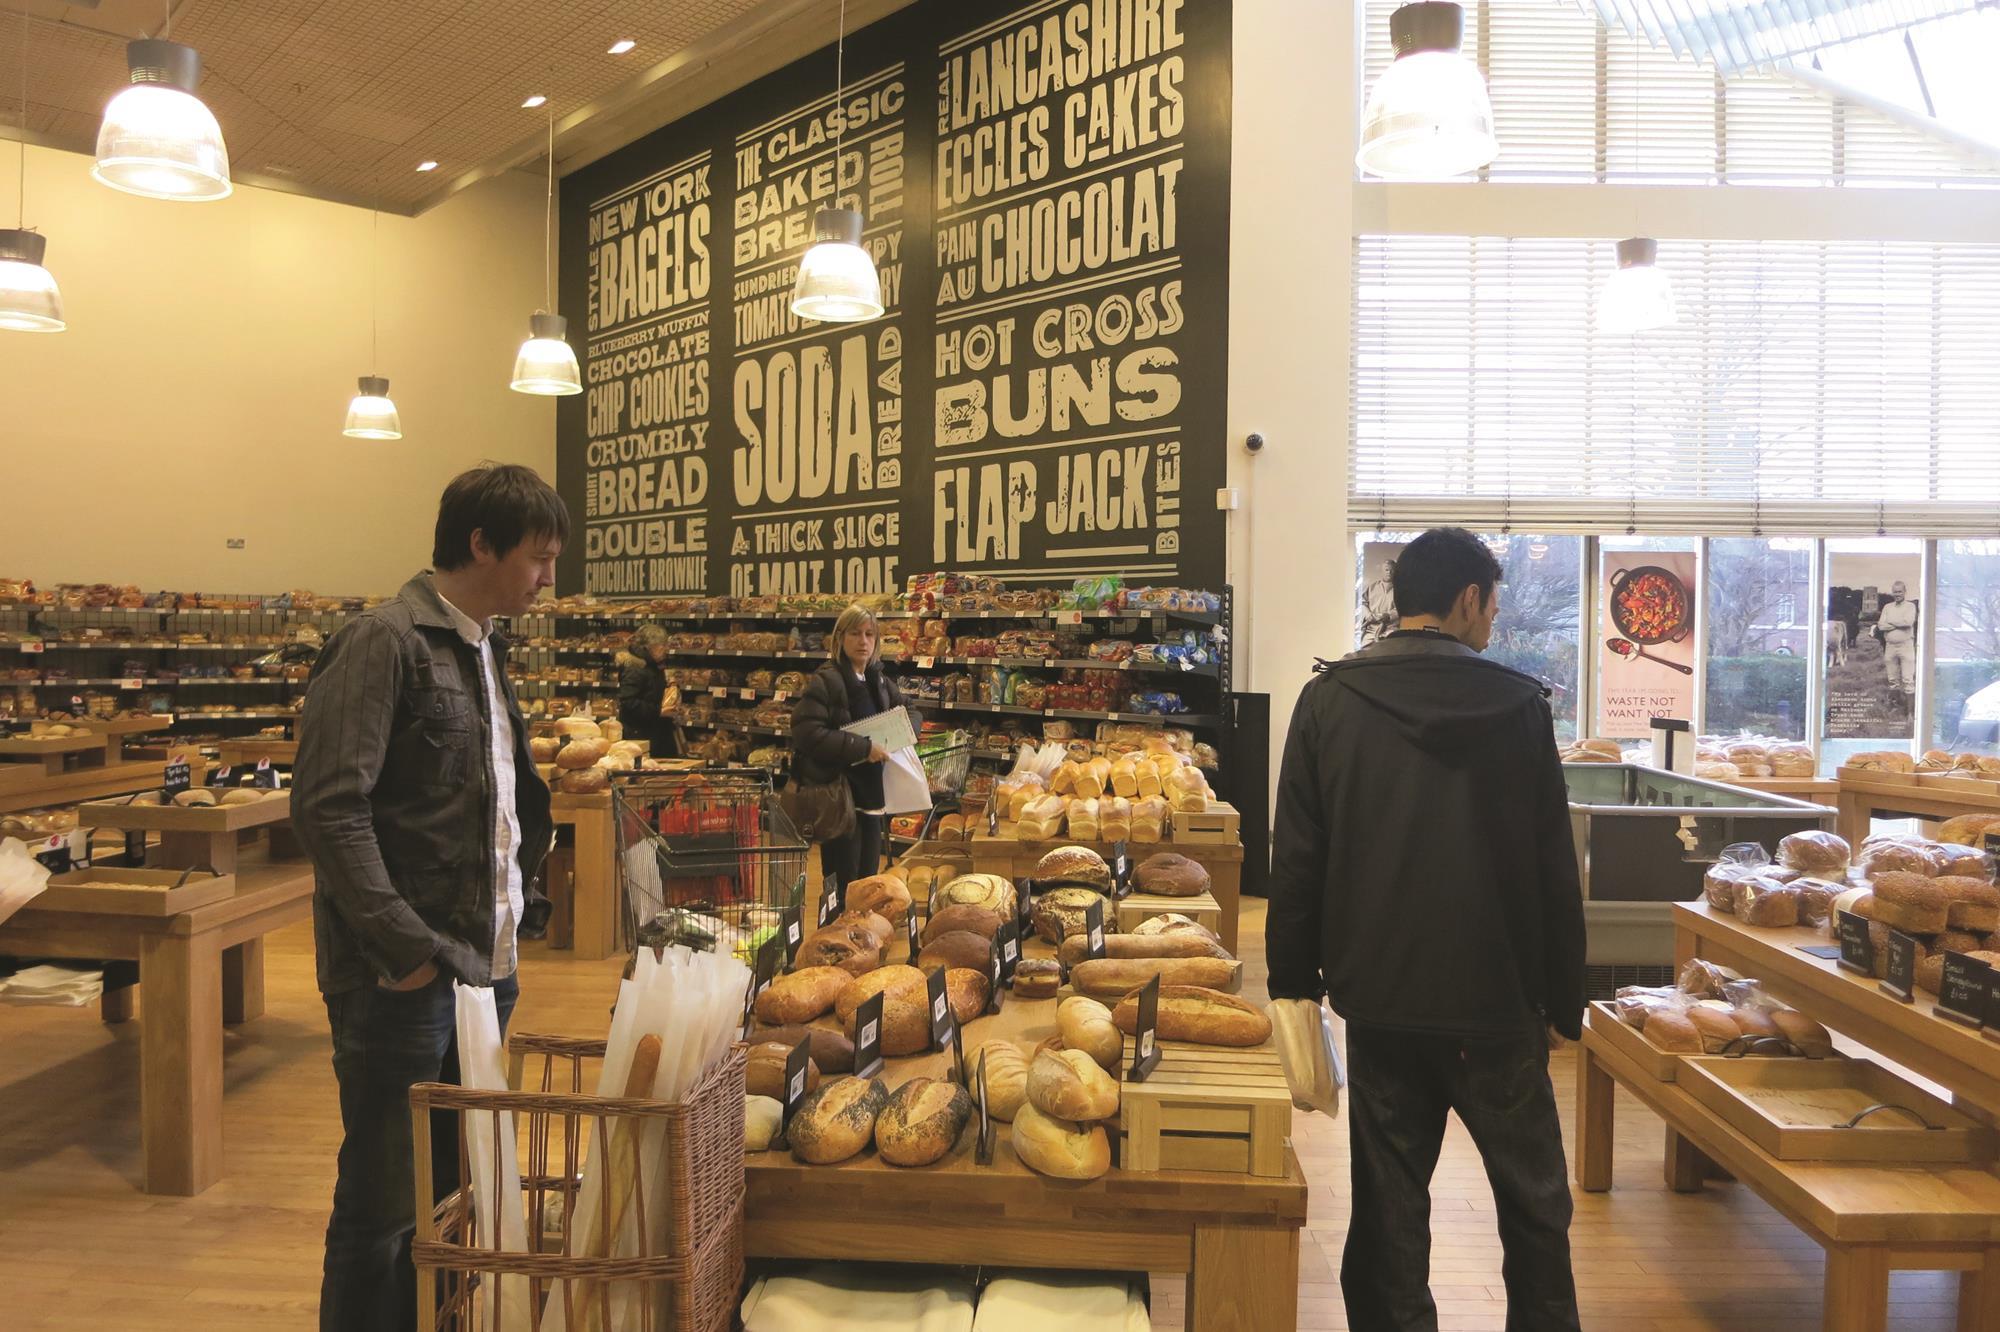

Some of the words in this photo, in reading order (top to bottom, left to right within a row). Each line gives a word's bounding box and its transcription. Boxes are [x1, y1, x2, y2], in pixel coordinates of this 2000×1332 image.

[938, 61, 949, 136] REAL
[952, 0, 1185, 131] LANCASHIRE
[735, 141, 762, 191] THE
[767, 81, 904, 163] CLASSIC
[937, 105, 1050, 210] ECCLES
[1064, 55, 1185, 169] CAKES
[589, 197, 639, 245] NEW
[645, 165, 712, 222] YORK
[734, 150, 864, 229] BAKED
[869, 131, 904, 222] ROLL
[937, 220, 977, 267] PAIN
[981, 158, 1184, 293] CHOCOLAT
[588, 247, 599, 332] STYLE
[600, 203, 711, 329] BAGELS
[734, 265, 800, 301] SUNDRIED
[936, 265, 976, 306] AU
[588, 328, 656, 359] BLUEBERRY
[657, 310, 711, 338] MUFFIN
[734, 288, 799, 347] TOMATO
[935, 317, 1016, 378] HOT
[1032, 280, 1184, 359] CROSS
[587, 330, 710, 384] CHOCOLATE
[587, 380, 625, 438] CHIP
[630, 360, 710, 430] COOKIES
[733, 334, 873, 507] SODA
[877, 326, 902, 489] BREAD
[935, 346, 1182, 448] BUNS
[586, 421, 710, 468] CRUMBLY
[586, 472, 598, 517] SHORT
[599, 455, 709, 516] BREAD
[933, 460, 1037, 564] FLAP
[1046, 445, 1150, 535] JACK
[1155, 441, 1181, 555] BITES
[586, 517, 708, 559] DOUBLE
[731, 526, 750, 556] A
[754, 519, 824, 554] THICK
[832, 512, 900, 550] SLICE
[585, 559, 646, 593] CHOCOLATE
[649, 556, 708, 592] BROWNIE
[731, 562, 755, 598] OF
[759, 560, 825, 597] MALT
[834, 556, 900, 596] LOAF
[1607, 696, 1646, 706] WASTE
[1649, 696, 1676, 706] NOT
[1607, 709, 1643, 718] WANT
[1647, 709, 1673, 718] NOT
